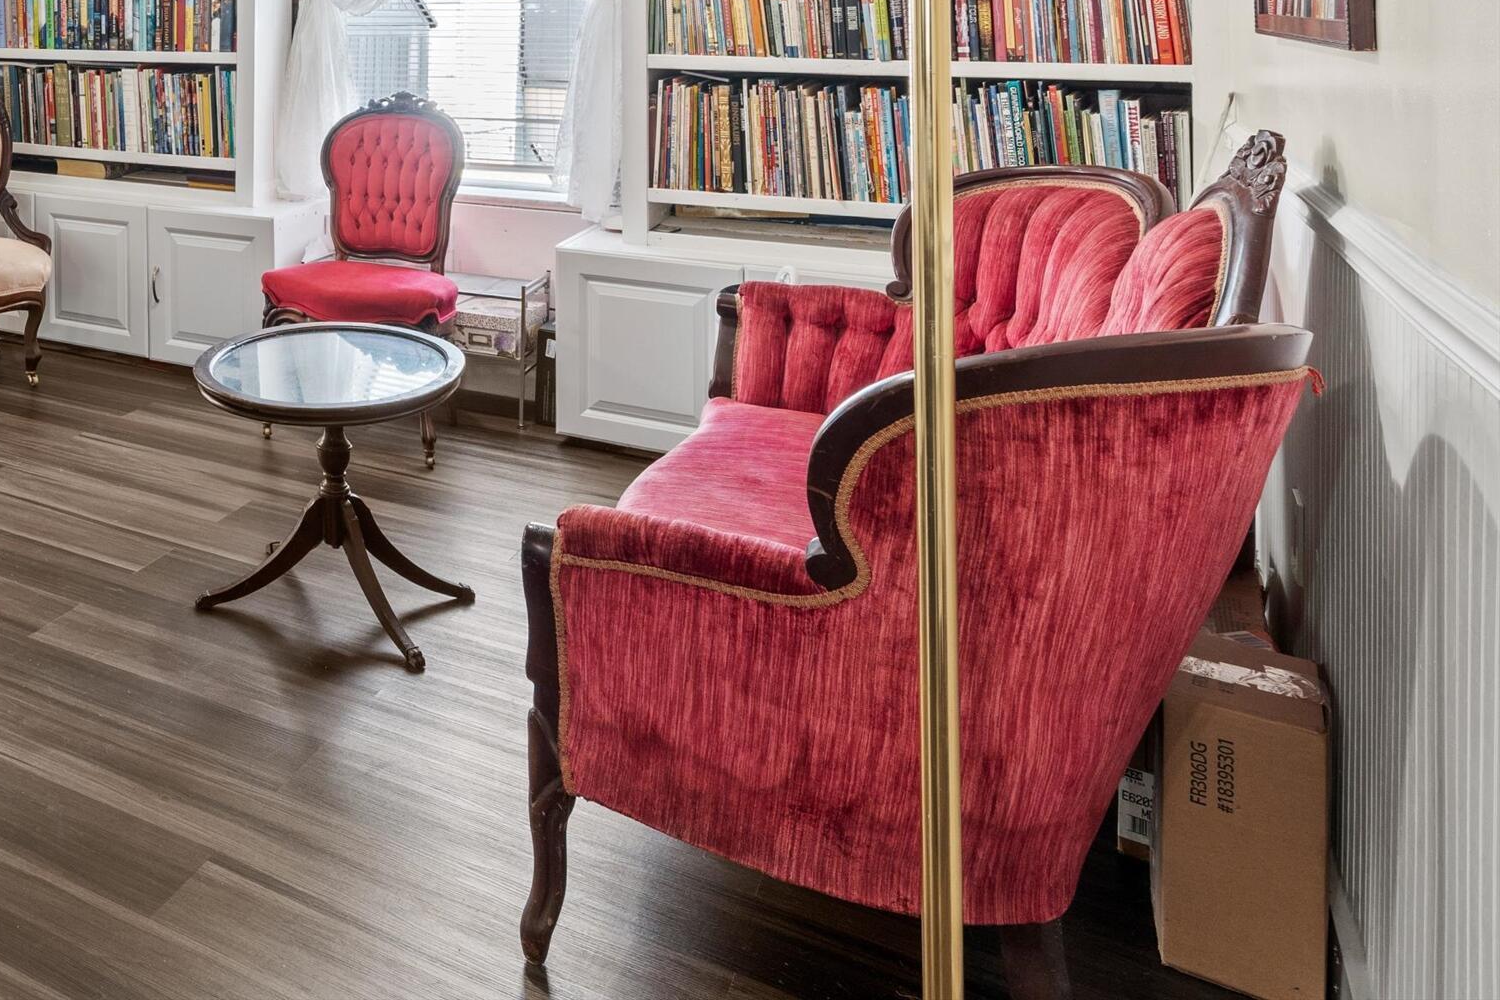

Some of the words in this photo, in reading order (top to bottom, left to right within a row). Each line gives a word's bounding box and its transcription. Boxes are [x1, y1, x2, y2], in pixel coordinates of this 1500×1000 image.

[1128, 106, 1140, 145] TITANIC
[1190, 741, 1207, 807] FR306DG
[1217, 738, 1235, 814] #18395301
